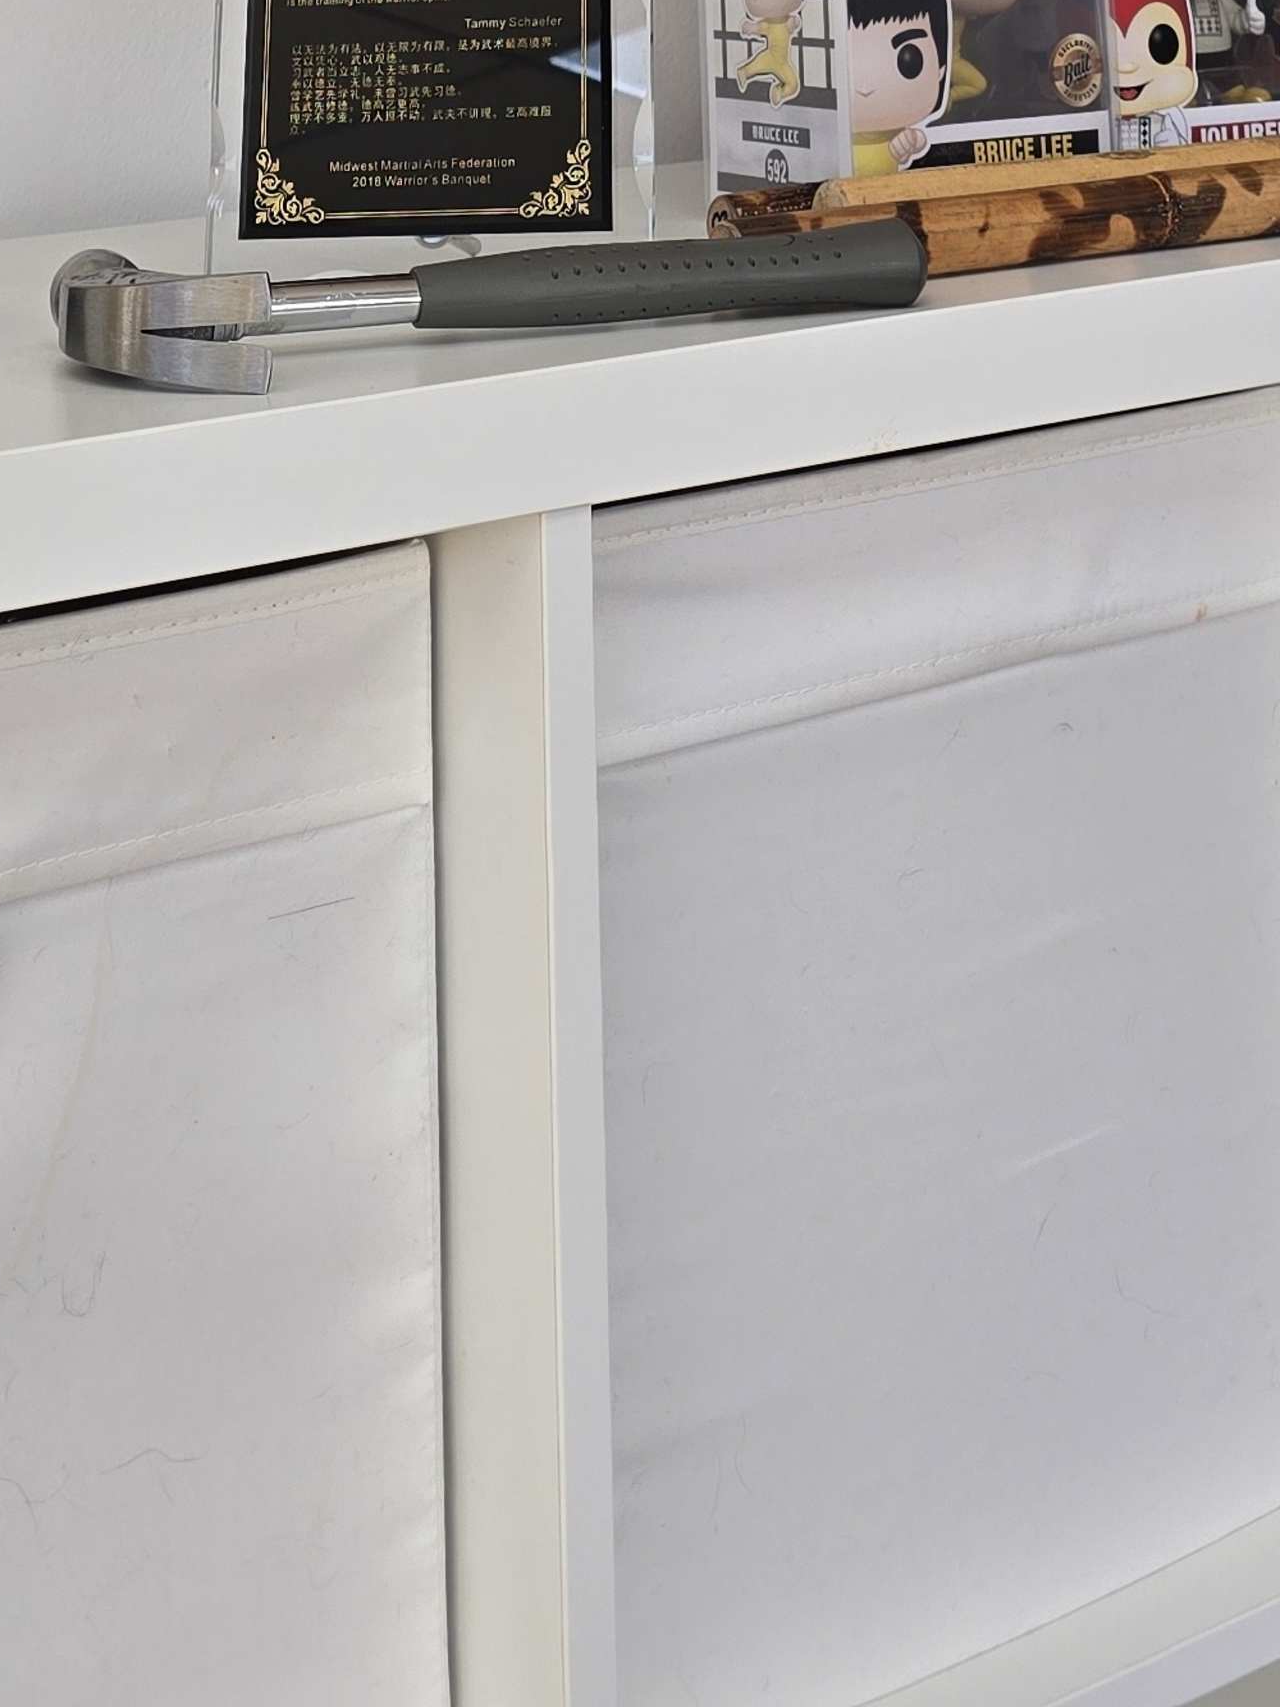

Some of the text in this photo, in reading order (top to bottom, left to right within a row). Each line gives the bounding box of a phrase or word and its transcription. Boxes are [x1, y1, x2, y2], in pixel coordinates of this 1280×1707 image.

[464, 15, 562, 30] Tammy Schaefer
[752, 125, 799, 144] BRUCE LEE
[973, 133, 1073, 165] BRUCE LEE
[329, 157, 516, 172] Midwest Martial Arts Federation
[767, 158, 787, 183] 592
[352, 175, 381, 188] 2018
[441, 173, 492, 187] Banquet
